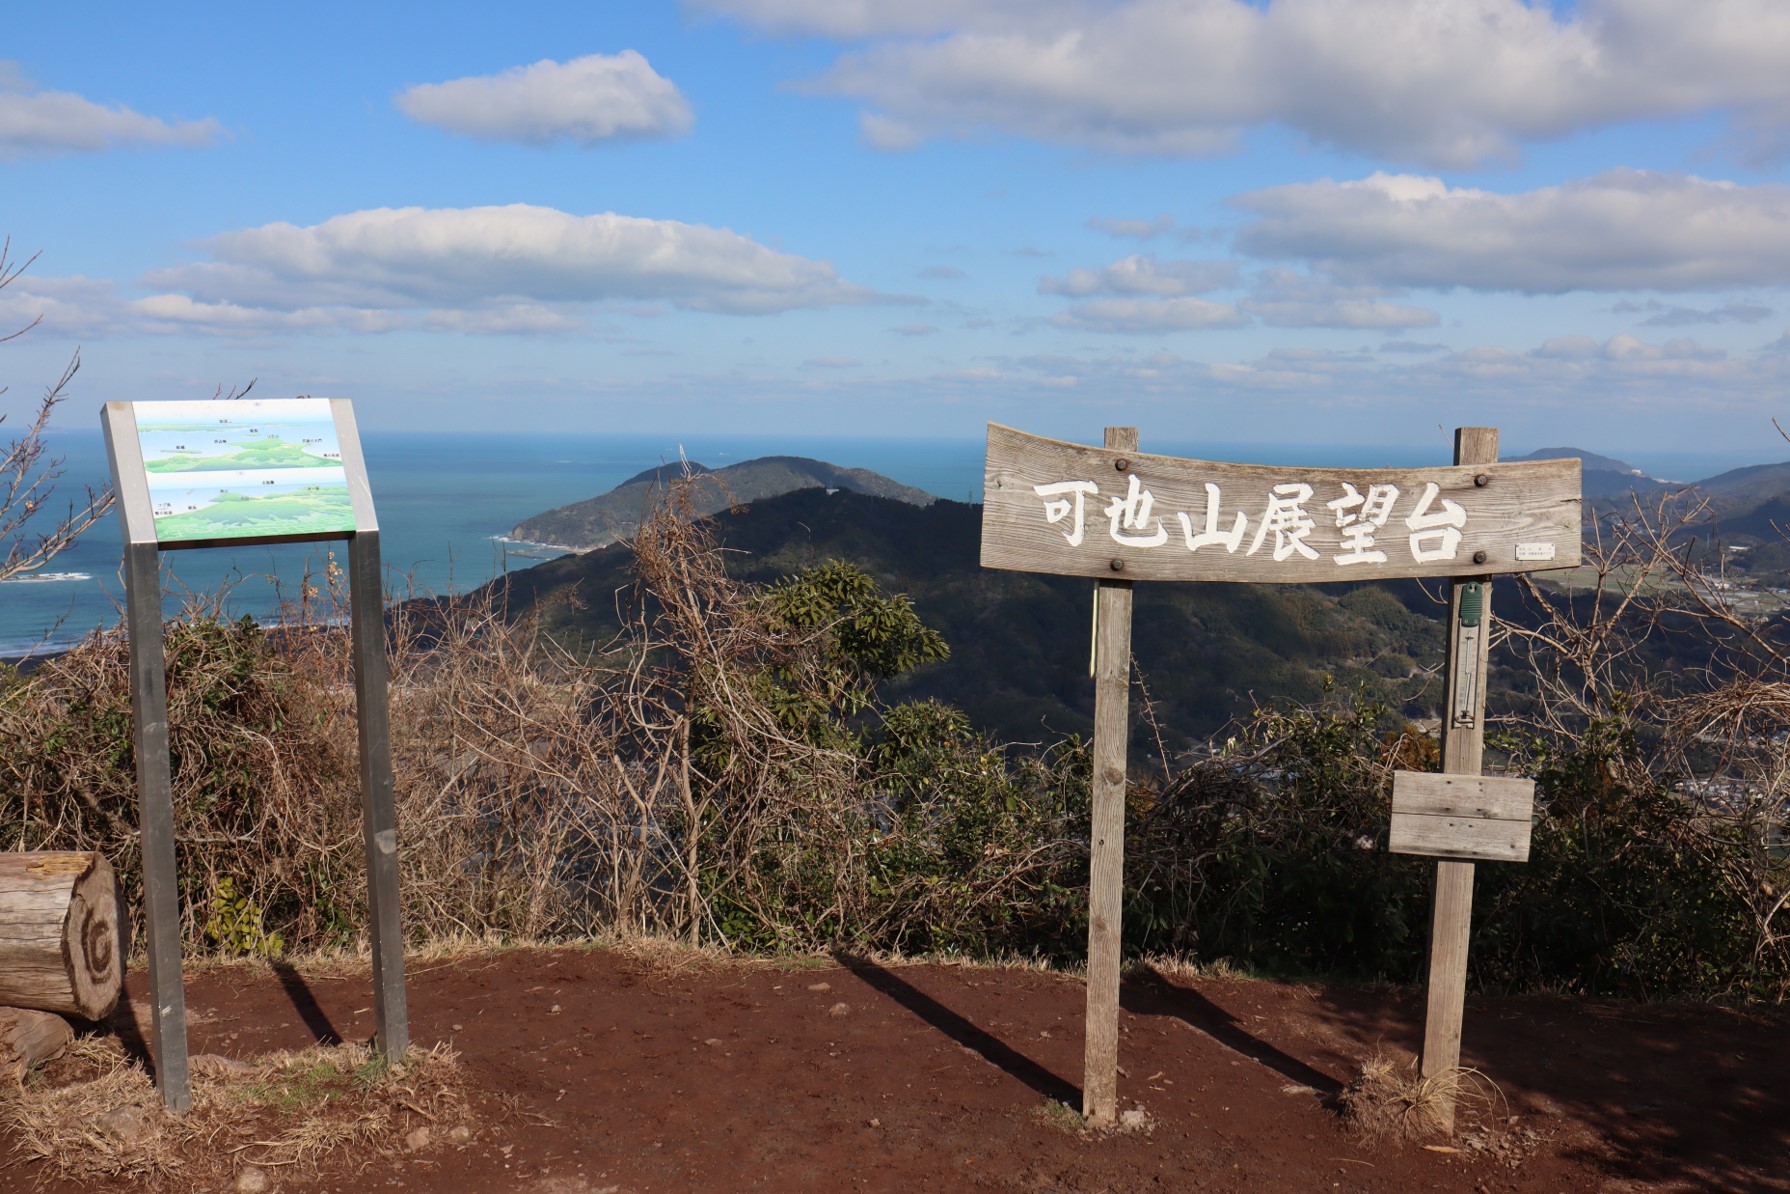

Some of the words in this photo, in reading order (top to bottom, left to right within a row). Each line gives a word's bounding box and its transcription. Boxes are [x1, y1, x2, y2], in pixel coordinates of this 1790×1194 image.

[1033, 473, 1467, 566] 可也山展望台
